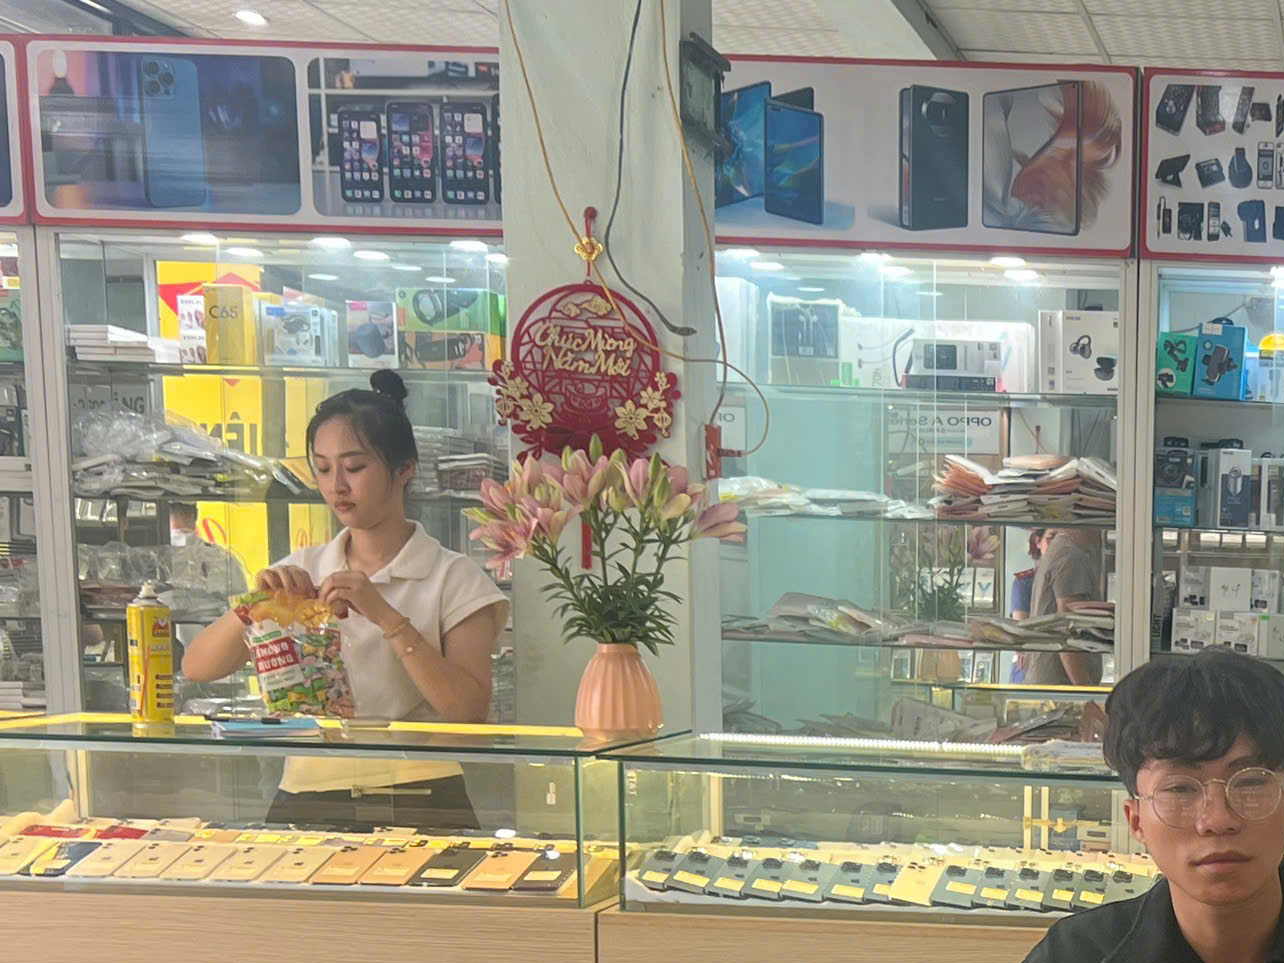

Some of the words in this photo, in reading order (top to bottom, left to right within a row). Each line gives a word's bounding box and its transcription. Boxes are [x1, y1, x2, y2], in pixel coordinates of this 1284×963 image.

[208, 304, 239, 319] C65
[534, 323, 583, 350] Chúc
[580, 327, 637, 356] Mừng
[542, 345, 591, 374] Năm
[587, 352, 632, 377] Mới
